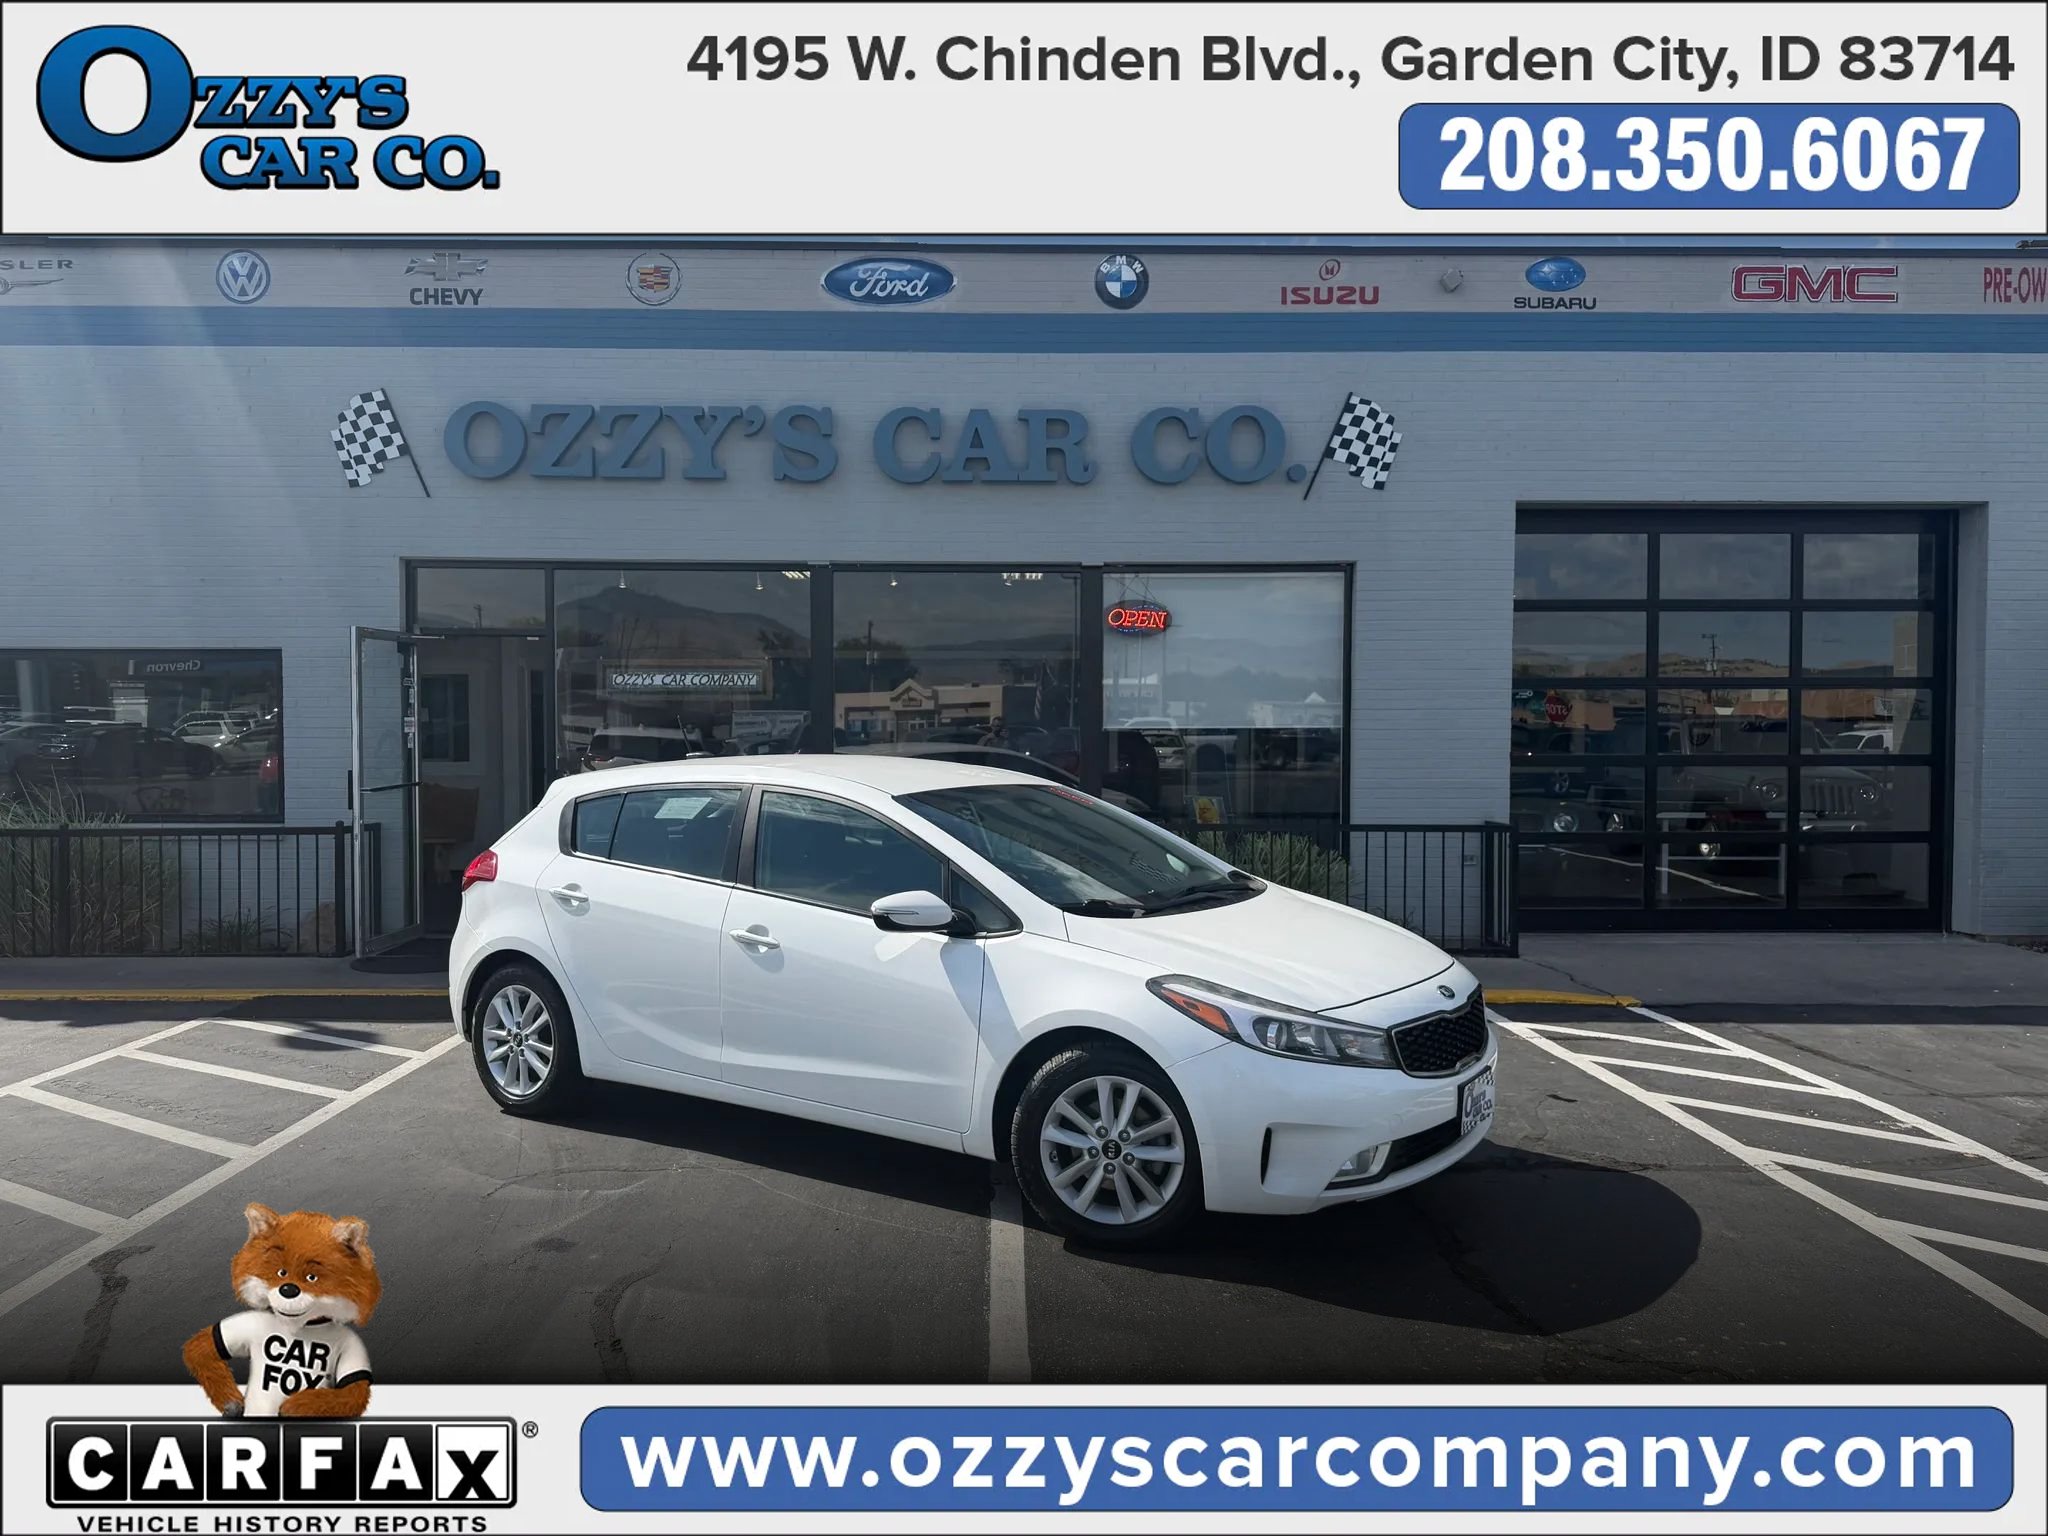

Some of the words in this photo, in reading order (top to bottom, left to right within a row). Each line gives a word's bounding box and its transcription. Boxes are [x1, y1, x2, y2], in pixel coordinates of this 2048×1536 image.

[0, 260, 73, 270] SLER
[1099, 255, 1145, 274] BMW
[849, 265, 931, 298] Ford
[1732, 264, 1898, 303] GMC
[409, 287, 484, 306] CHEVY
[1281, 286, 1380, 305] ISUZU
[1514, 297, 1597, 310] SUBARU
[443, 400, 839, 484] OZZY'S
[873, 405, 1098, 485] CAR
[1131, 404, 1307, 485] CO.
[1108, 608, 1168, 629] OPEN
[661, 673, 688, 686] CAR
[690, 673, 756, 686] COMPANY
